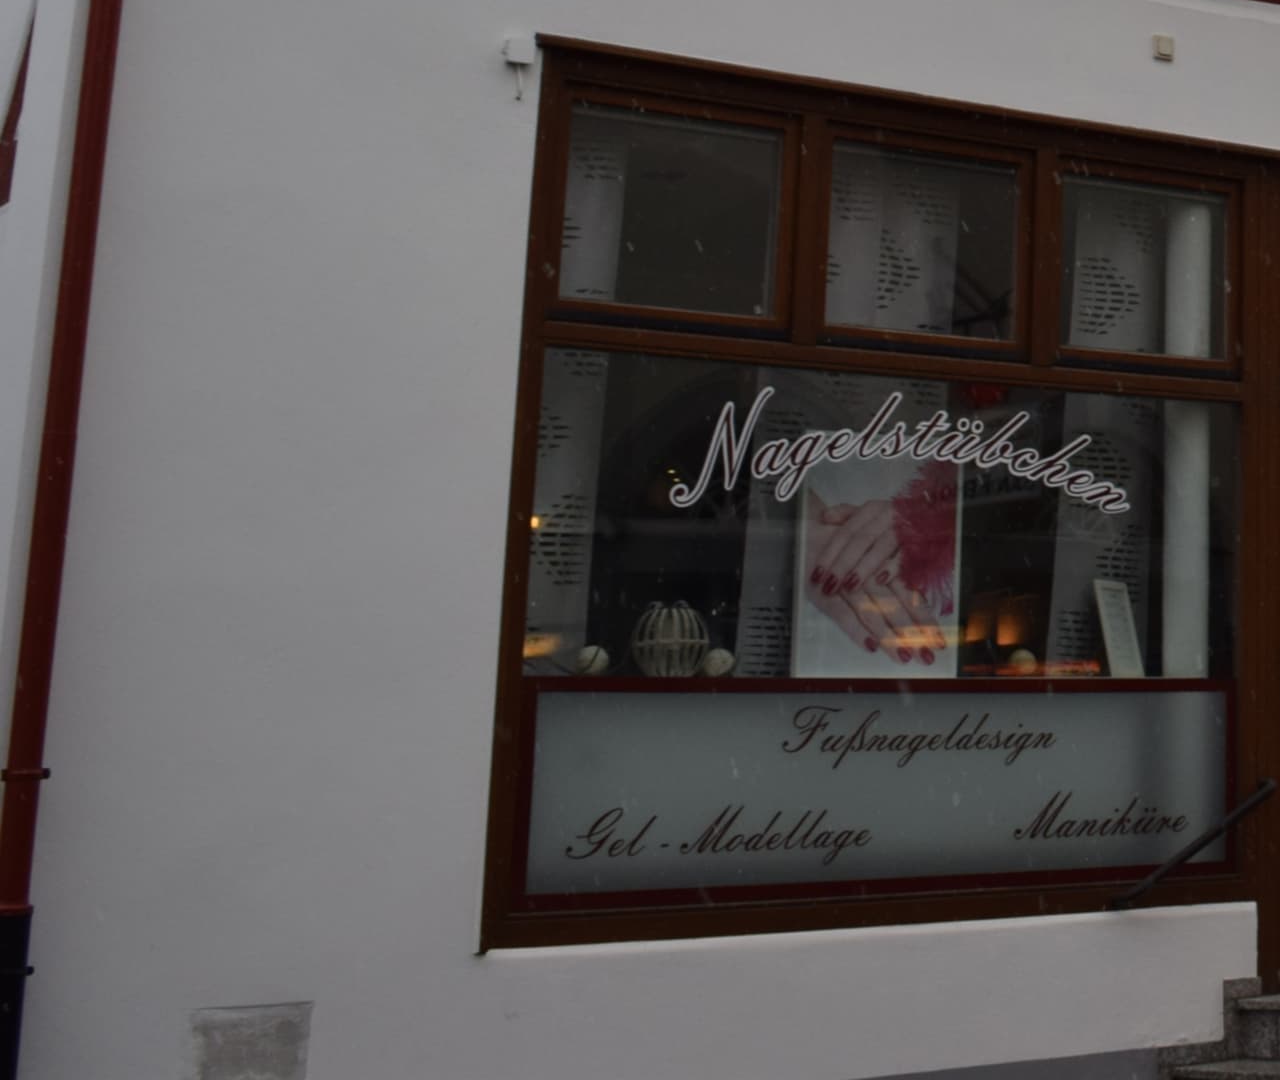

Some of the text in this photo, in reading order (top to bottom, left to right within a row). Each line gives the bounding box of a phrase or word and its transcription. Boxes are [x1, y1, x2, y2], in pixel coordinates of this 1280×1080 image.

[669, 386, 1130, 514] Nagelstübchen
[782, 705, 1056, 769] Fußnageldesign
[566, 808, 658, 860] Gel
[680, 805, 873, 866] Modellage
[1014, 791, 1188, 840] Maniküre
